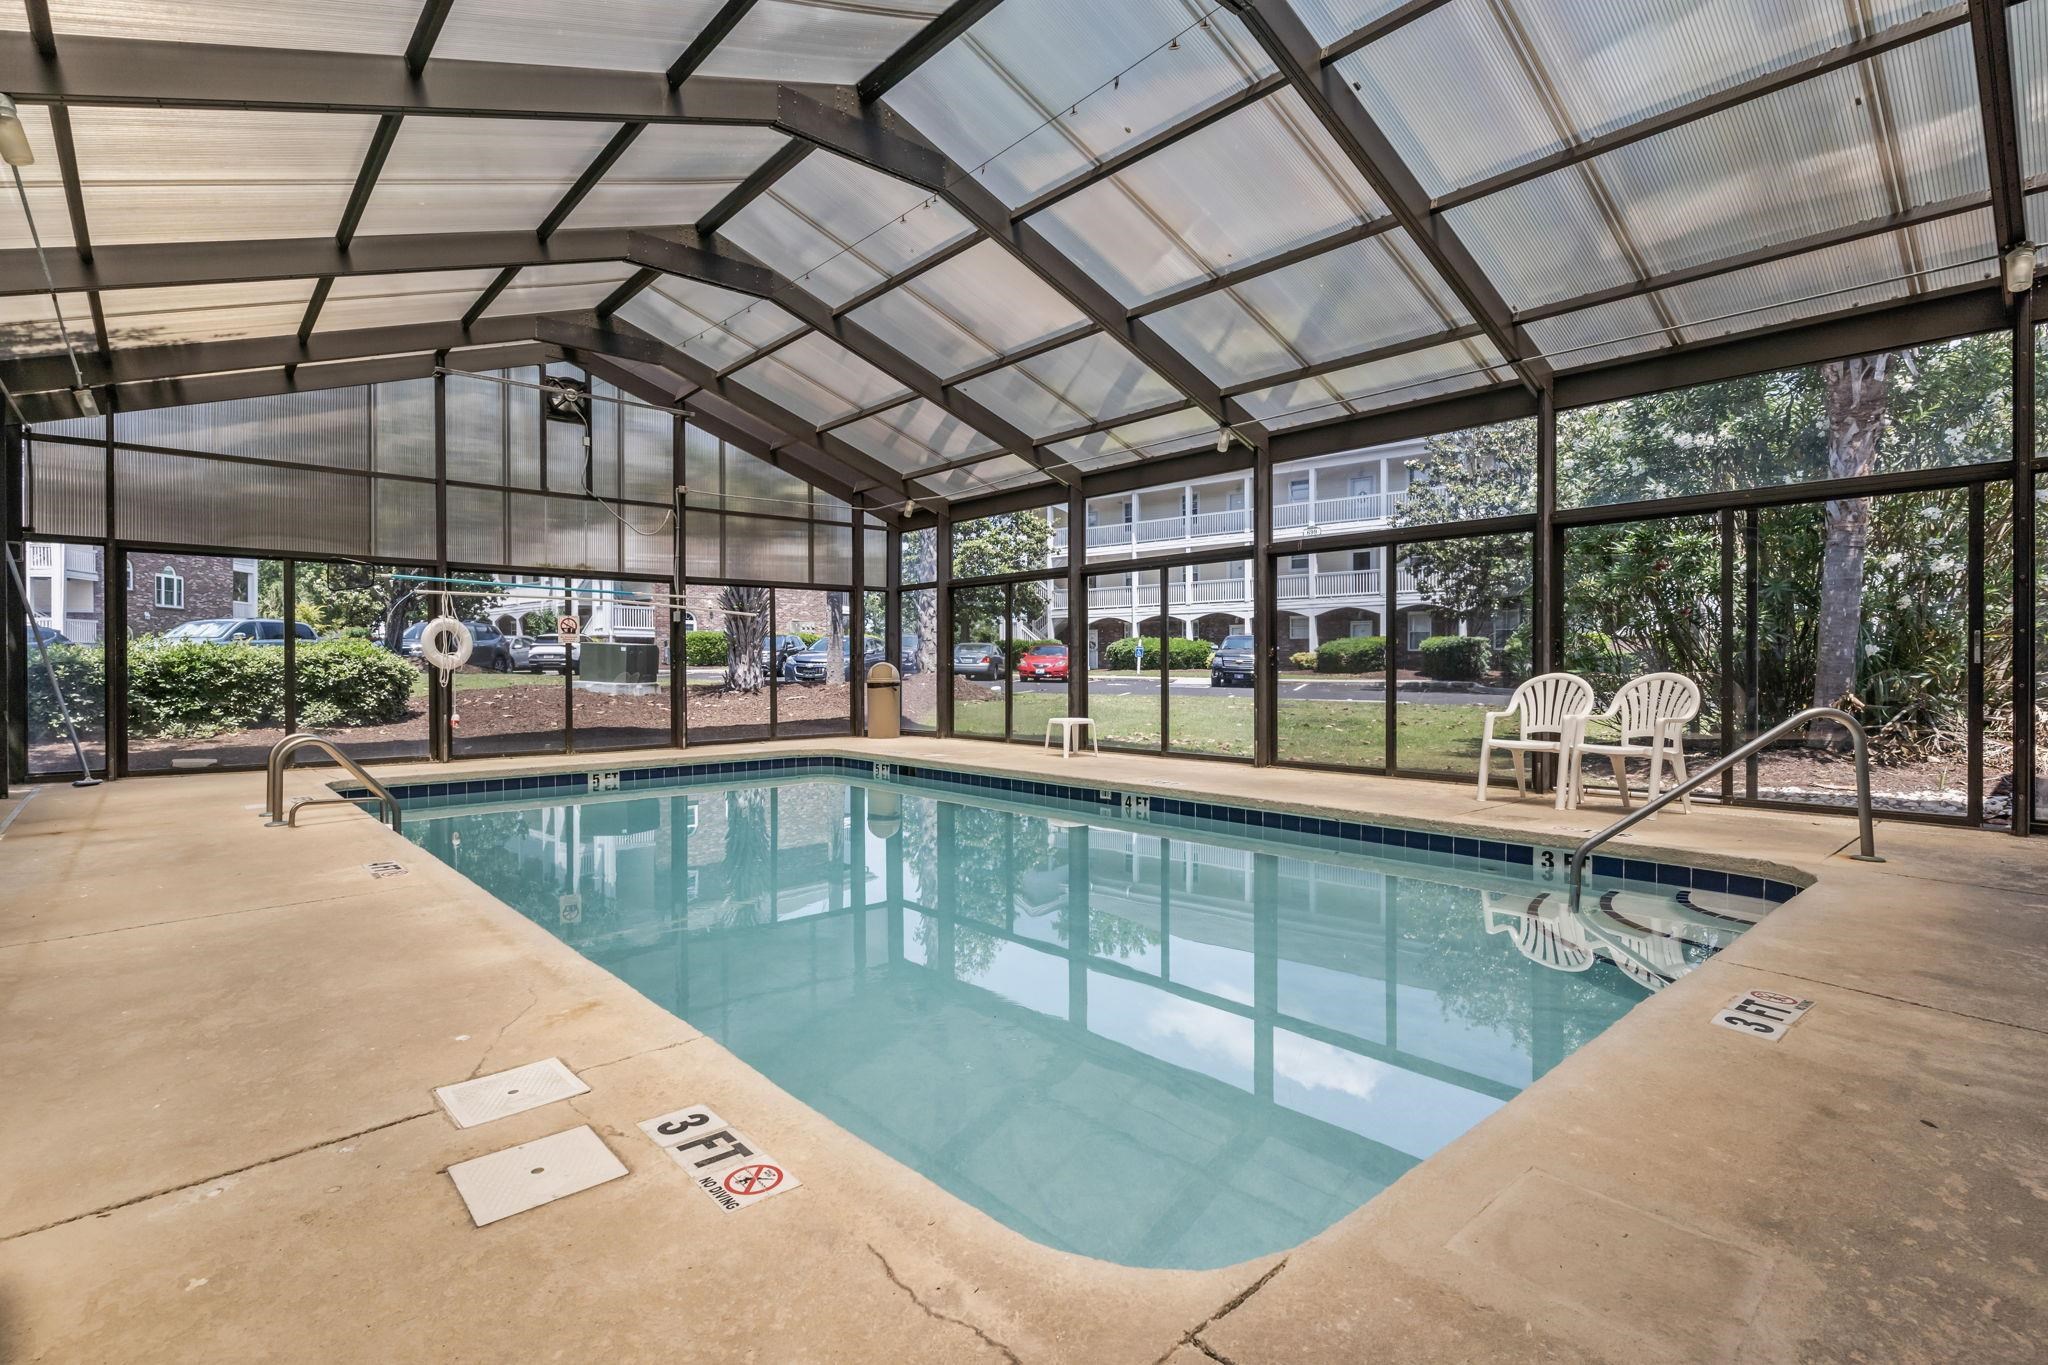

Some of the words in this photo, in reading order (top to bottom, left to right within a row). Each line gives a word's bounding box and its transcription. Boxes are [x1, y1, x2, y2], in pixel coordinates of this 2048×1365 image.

[592, 774, 600, 784] 5
[1125, 796, 1132, 808] 4
[1136, 796, 1149, 806] FT
[1541, 850, 1555, 868] 3
[1735, 998, 1792, 1022] FT
[1724, 1016, 1775, 1033] 3
[657, 1113, 710, 1136] 3
[676, 1130, 754, 1168] FT
[698, 1176, 717, 1188] NO
[708, 1186, 740, 1210] DIVING
